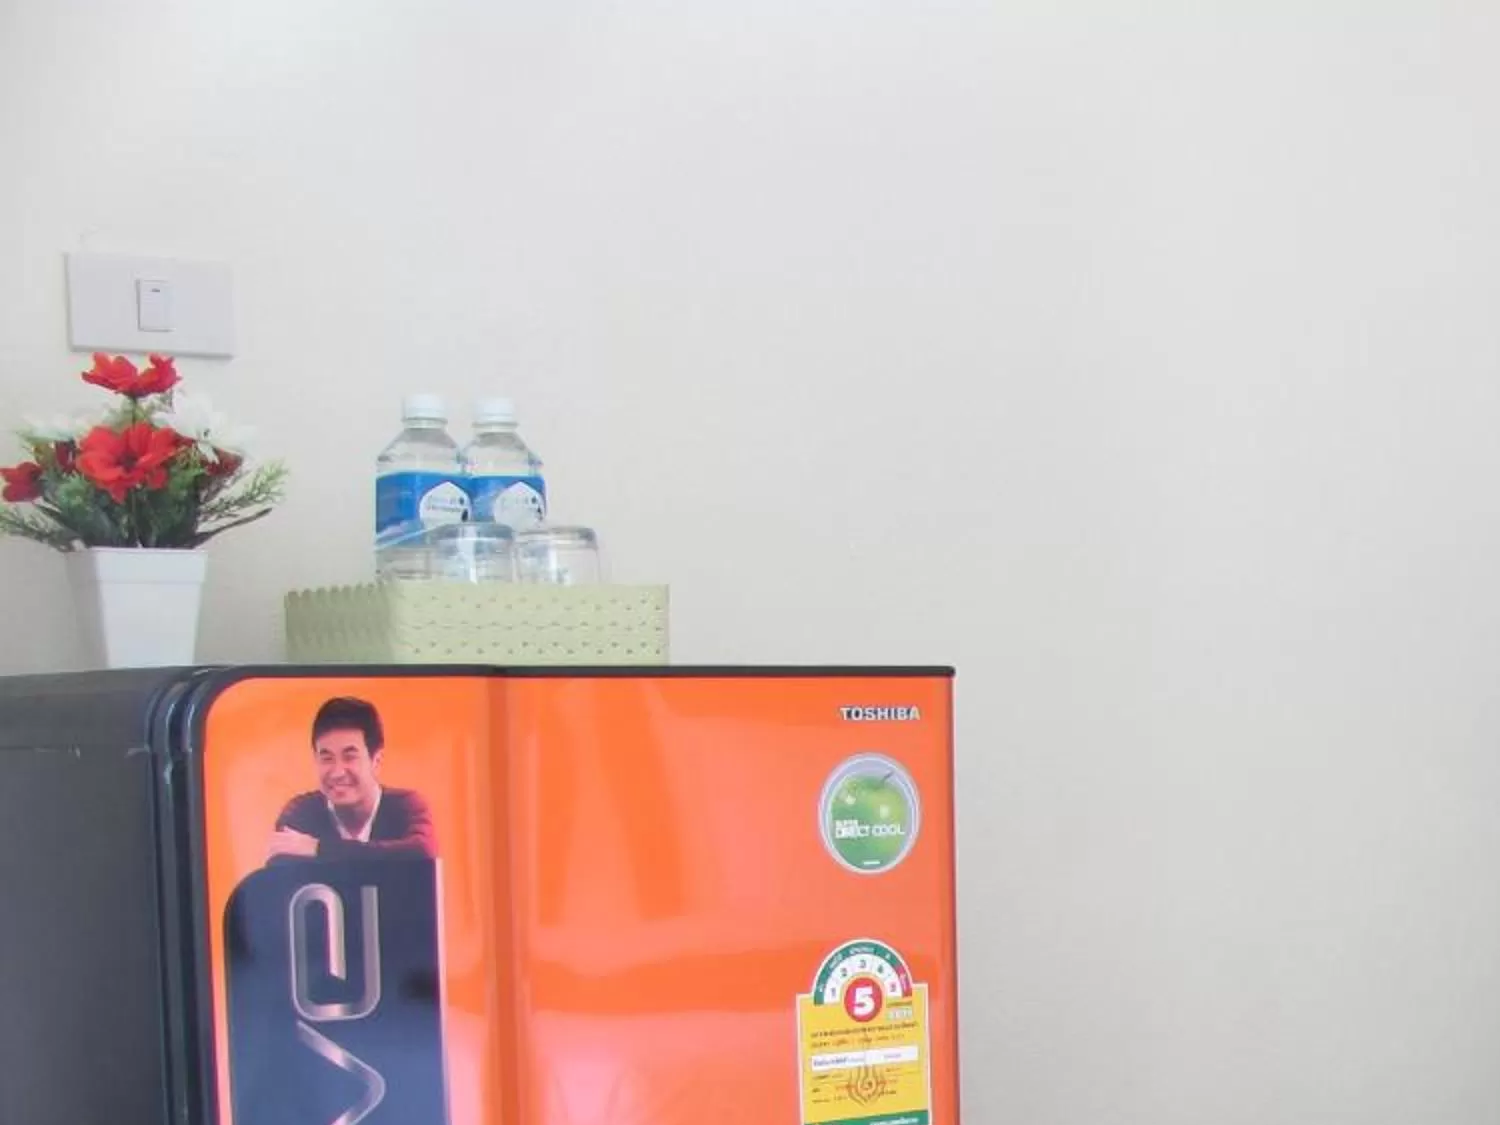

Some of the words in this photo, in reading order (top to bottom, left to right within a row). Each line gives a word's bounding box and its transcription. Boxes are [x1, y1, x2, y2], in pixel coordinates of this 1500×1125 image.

[840, 706, 920, 721] TOSHIBA
[873, 823, 906, 836] COOL
[853, 986, 875, 1016] 5
